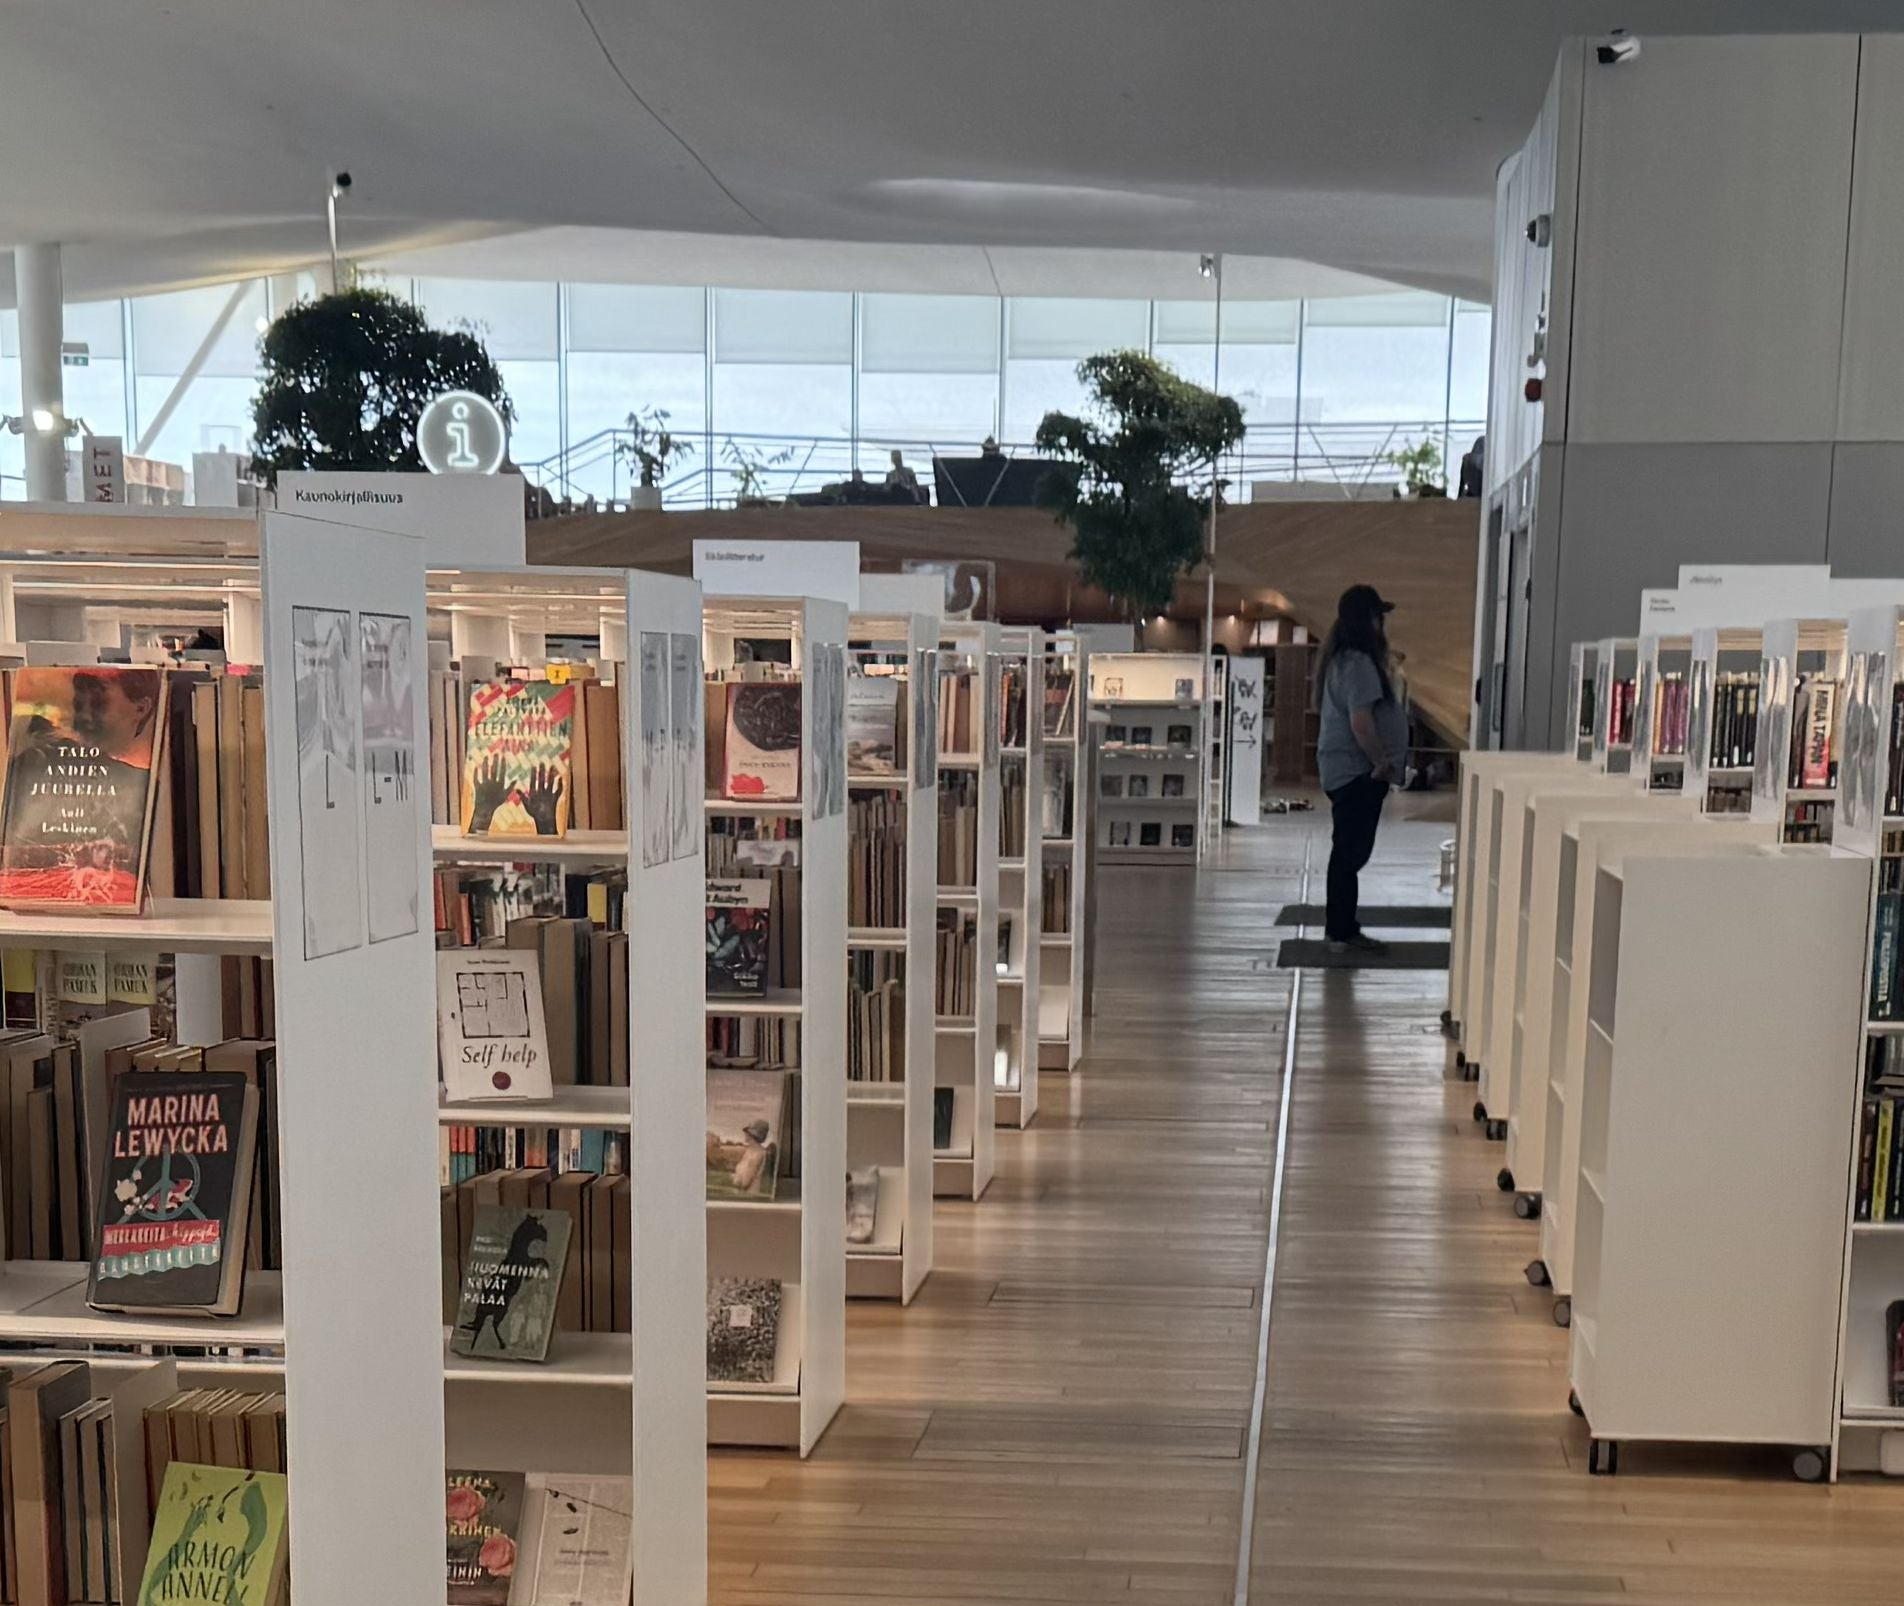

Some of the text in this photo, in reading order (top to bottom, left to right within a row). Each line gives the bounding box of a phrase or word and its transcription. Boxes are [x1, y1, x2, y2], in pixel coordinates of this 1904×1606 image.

[296, 490, 403, 505] Kaunokirjallisuus
[58, 747, 100, 757] TALO
[45, 765, 108, 776] ANDIEN
[461, 1042, 537, 1068] Self help
[128, 1093, 220, 1126] MARINA
[114, 1124, 228, 1158] LEWYCKA
[464, 1293, 505, 1306] PALAA
